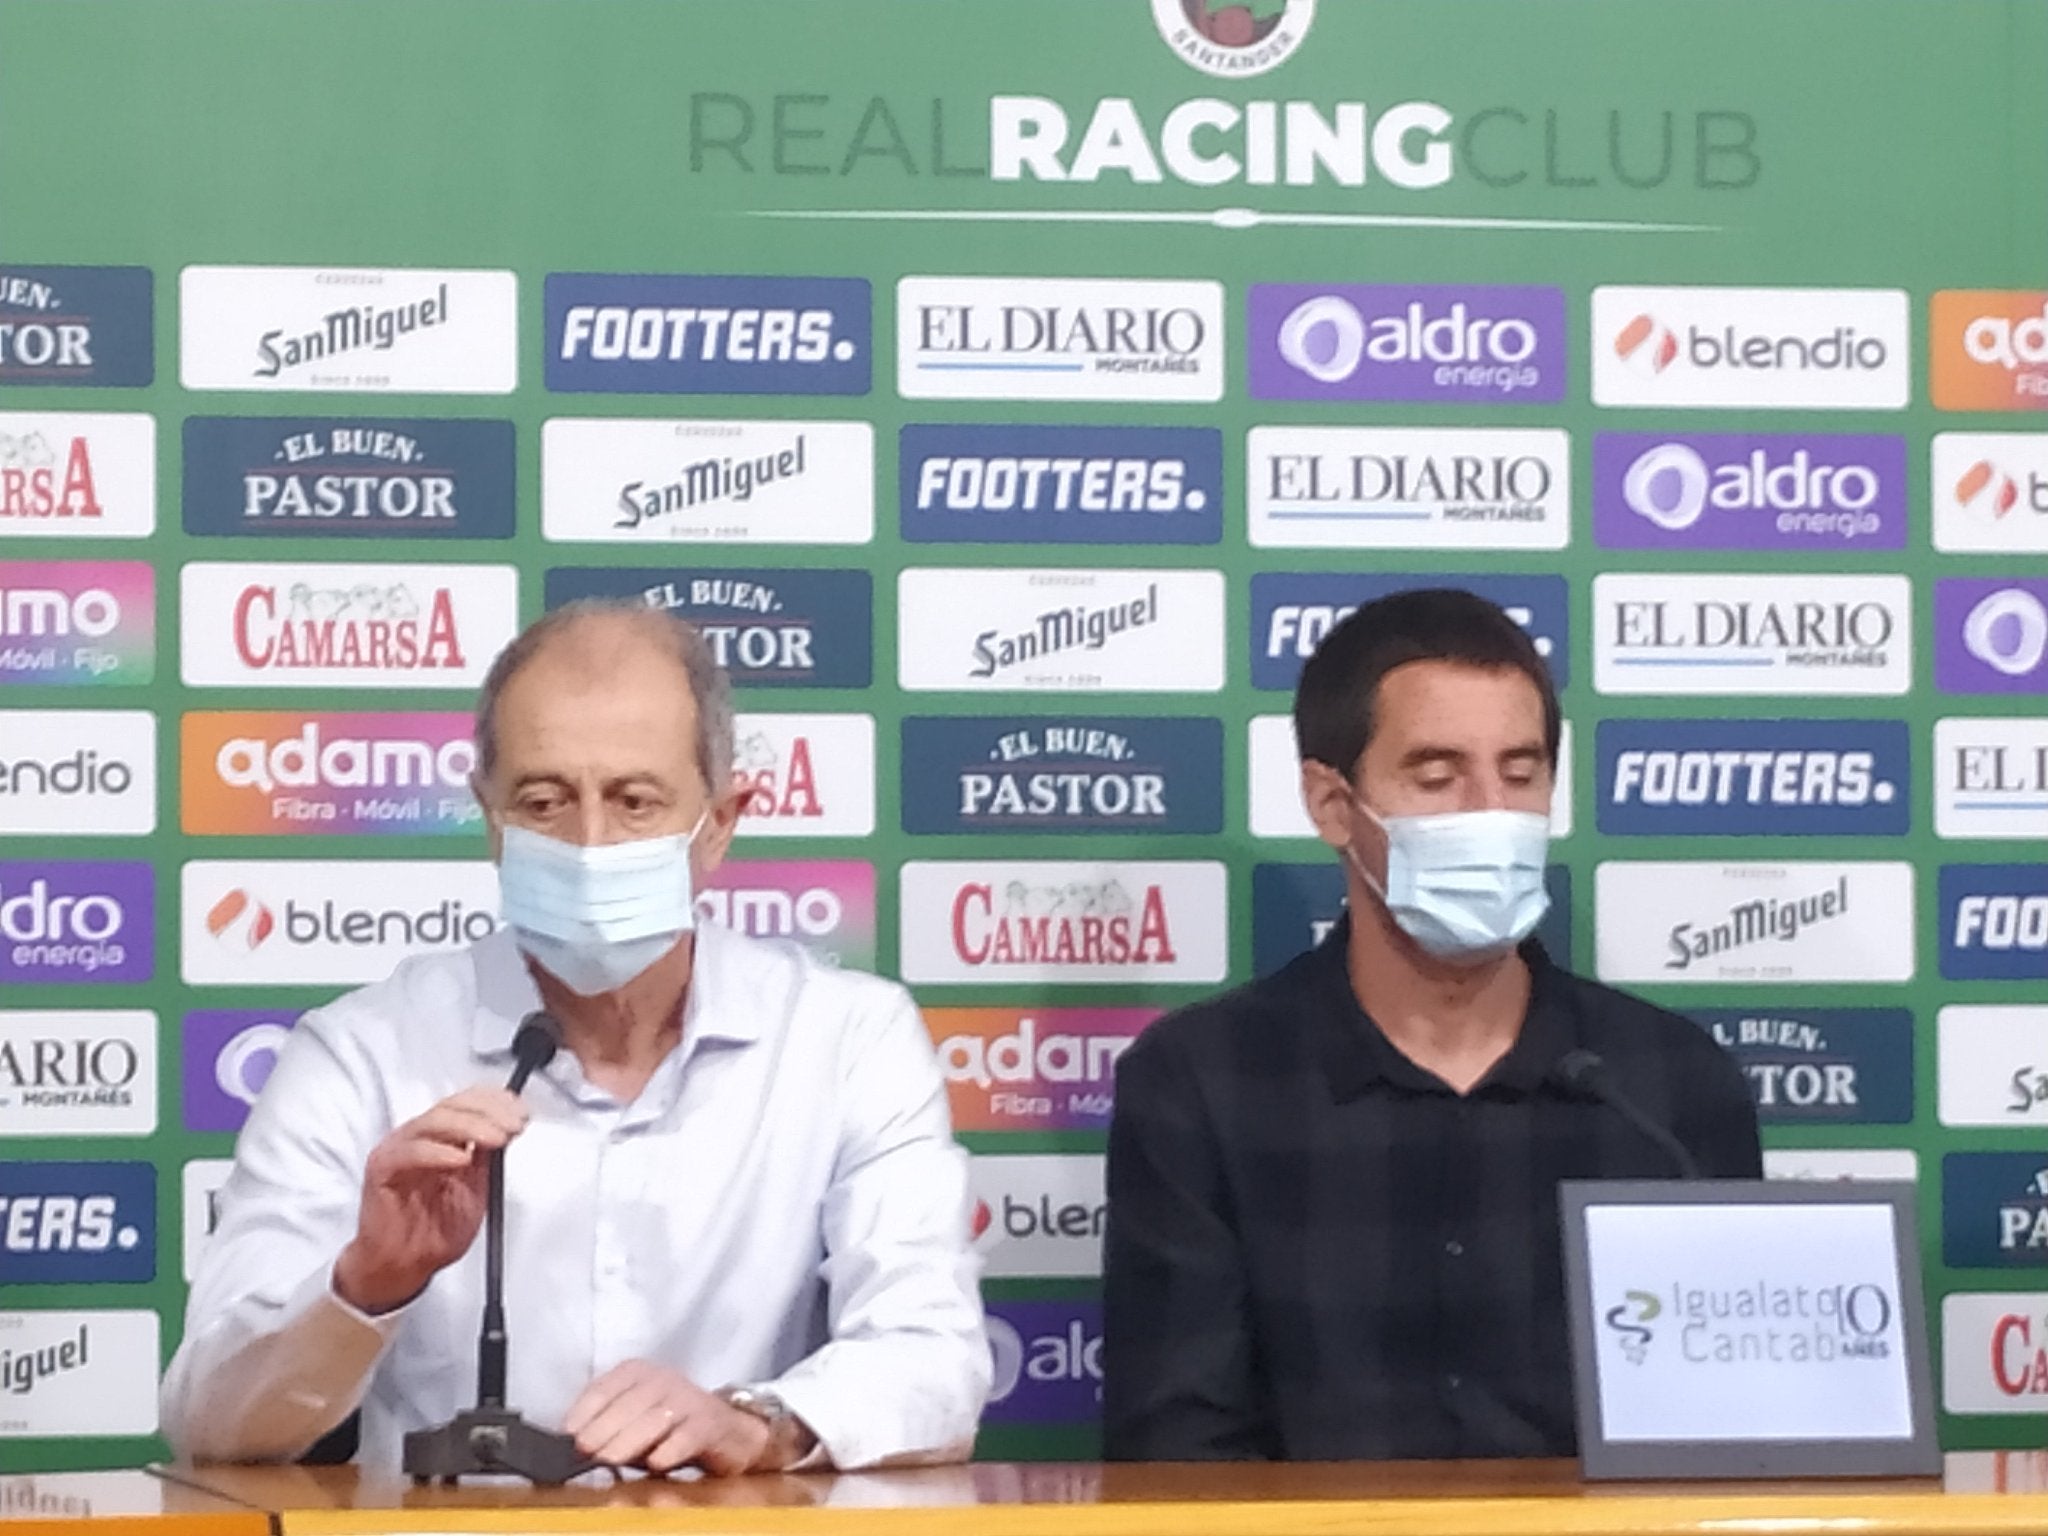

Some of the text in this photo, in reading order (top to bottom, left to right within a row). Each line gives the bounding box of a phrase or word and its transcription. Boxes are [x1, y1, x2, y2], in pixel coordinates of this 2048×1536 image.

[688, 93, 1764, 190] REAL RACING CLUB
[917, 306, 1204, 354] EL DIARIO
[1368, 303, 1536, 362] aldro
[1689, 326, 1886, 369] blendio
[244, 476, 457, 517] PASTOR
[1267, 455, 1550, 502] EL DIARIO
[1712, 449, 1878, 509] aldro
[0, 589, 118, 636] mo
[1614, 601, 1894, 648] EL DIARIO
[692, 627, 815, 668] TOR
[216, 722, 475, 793] adamo
[1955, 746, 2024, 792] EL
[960, 774, 1165, 815] PASTOR
[286, 900, 494, 944] blendio
[1743, 1064, 1858, 1104] TOR
